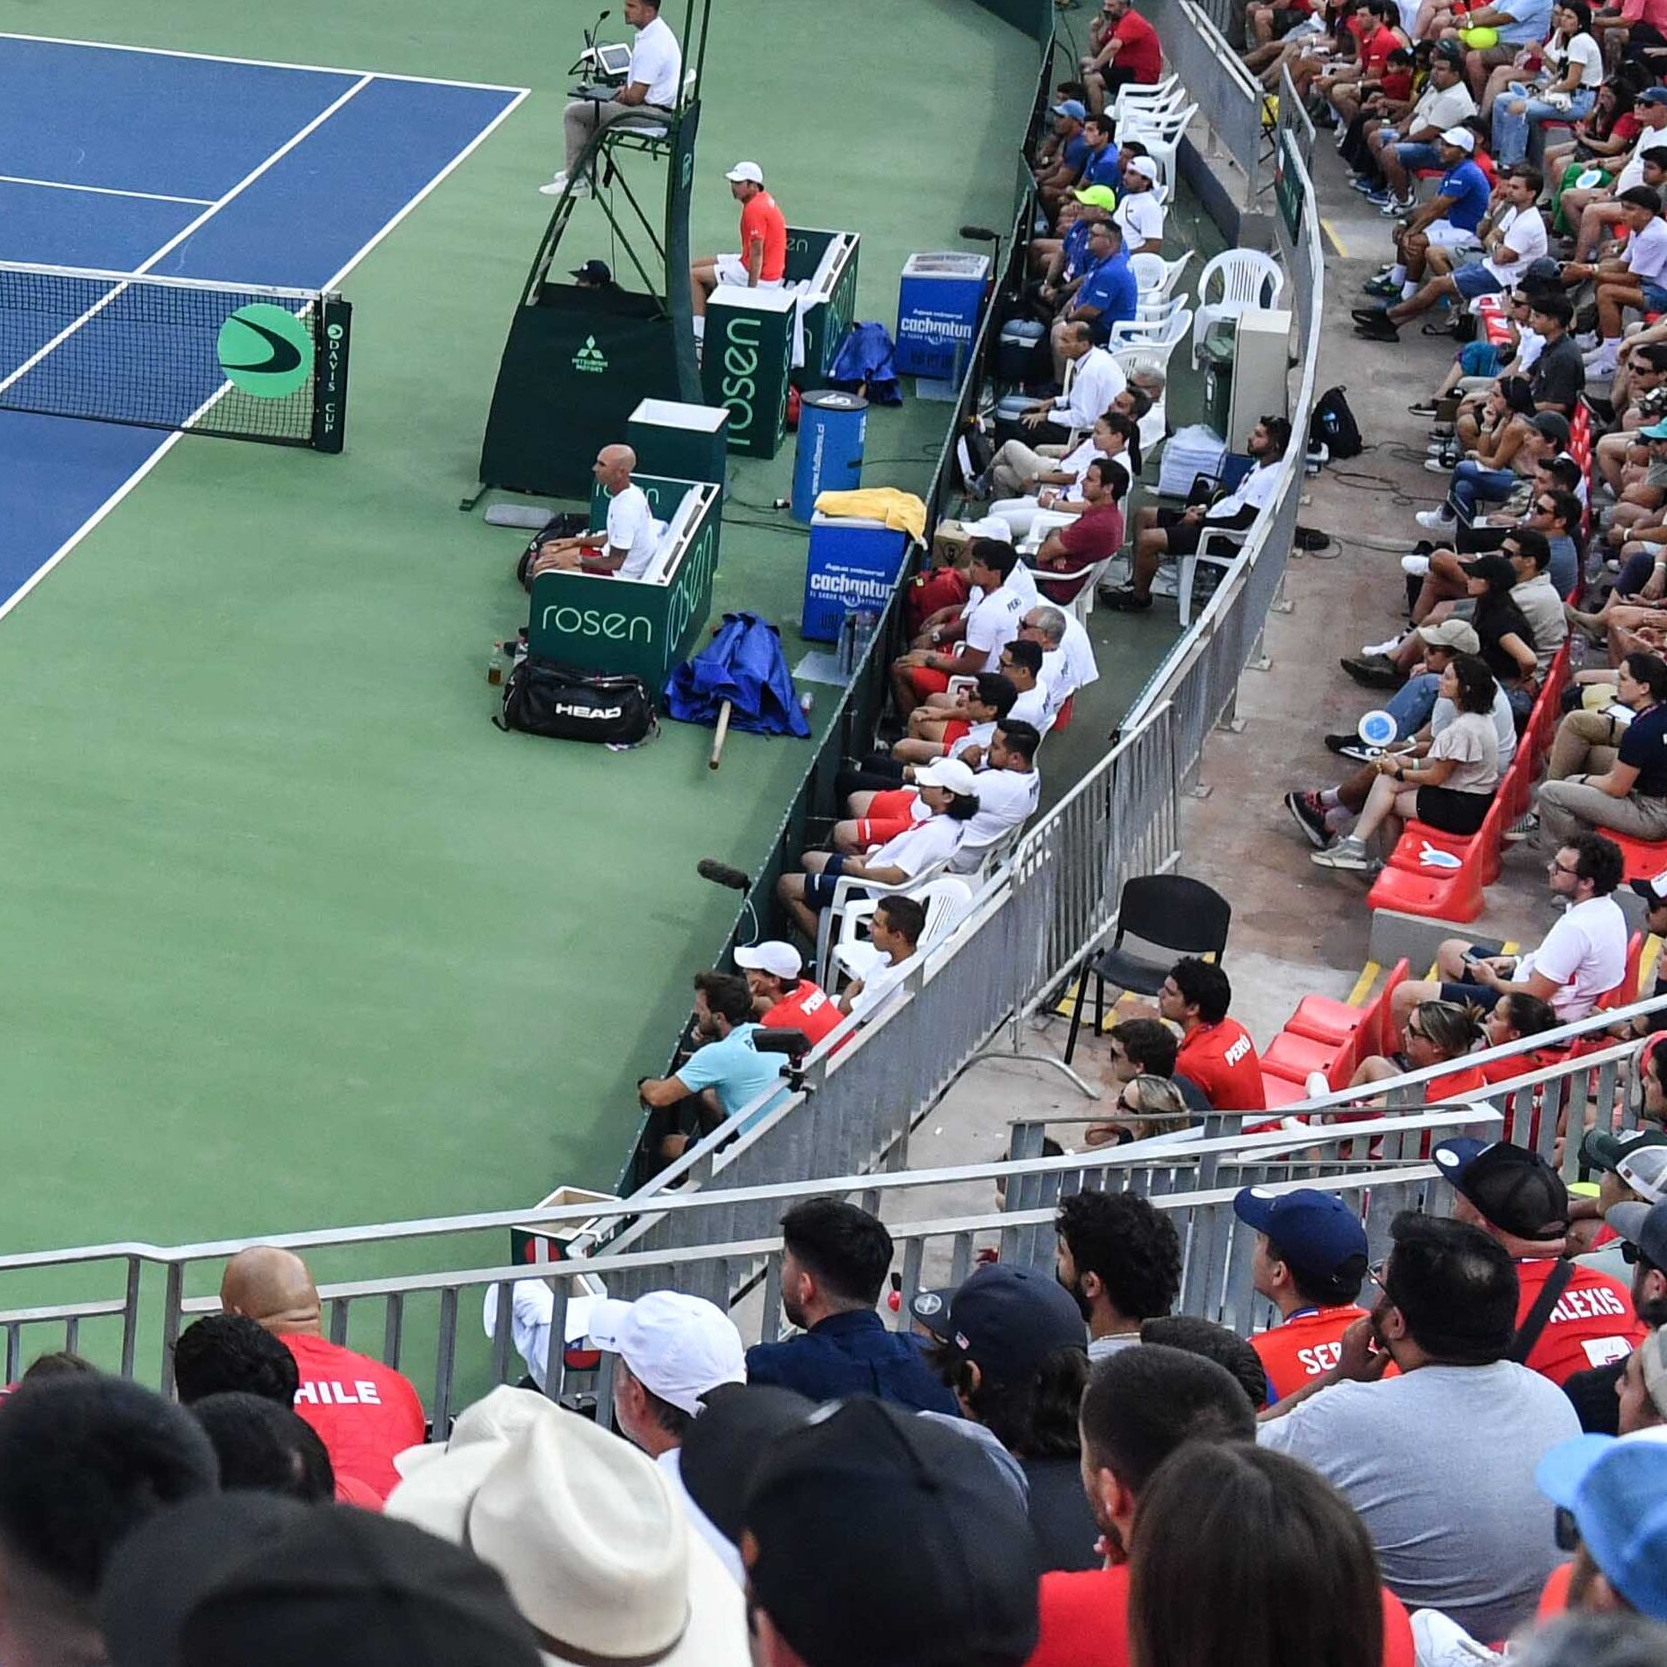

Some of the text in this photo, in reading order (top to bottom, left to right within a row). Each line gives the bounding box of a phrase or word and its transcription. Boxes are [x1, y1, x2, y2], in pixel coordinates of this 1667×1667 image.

[900, 317, 973, 339] cachantun
[324, 340, 340, 434] DAVIS CUP
[722, 317, 762, 446] rosen
[542, 605, 653, 644] rosen
[555, 702, 622, 720] HEAD
[1550, 1287, 1625, 1324] ALEXIS
[293, 1380, 382, 1405] HILE
